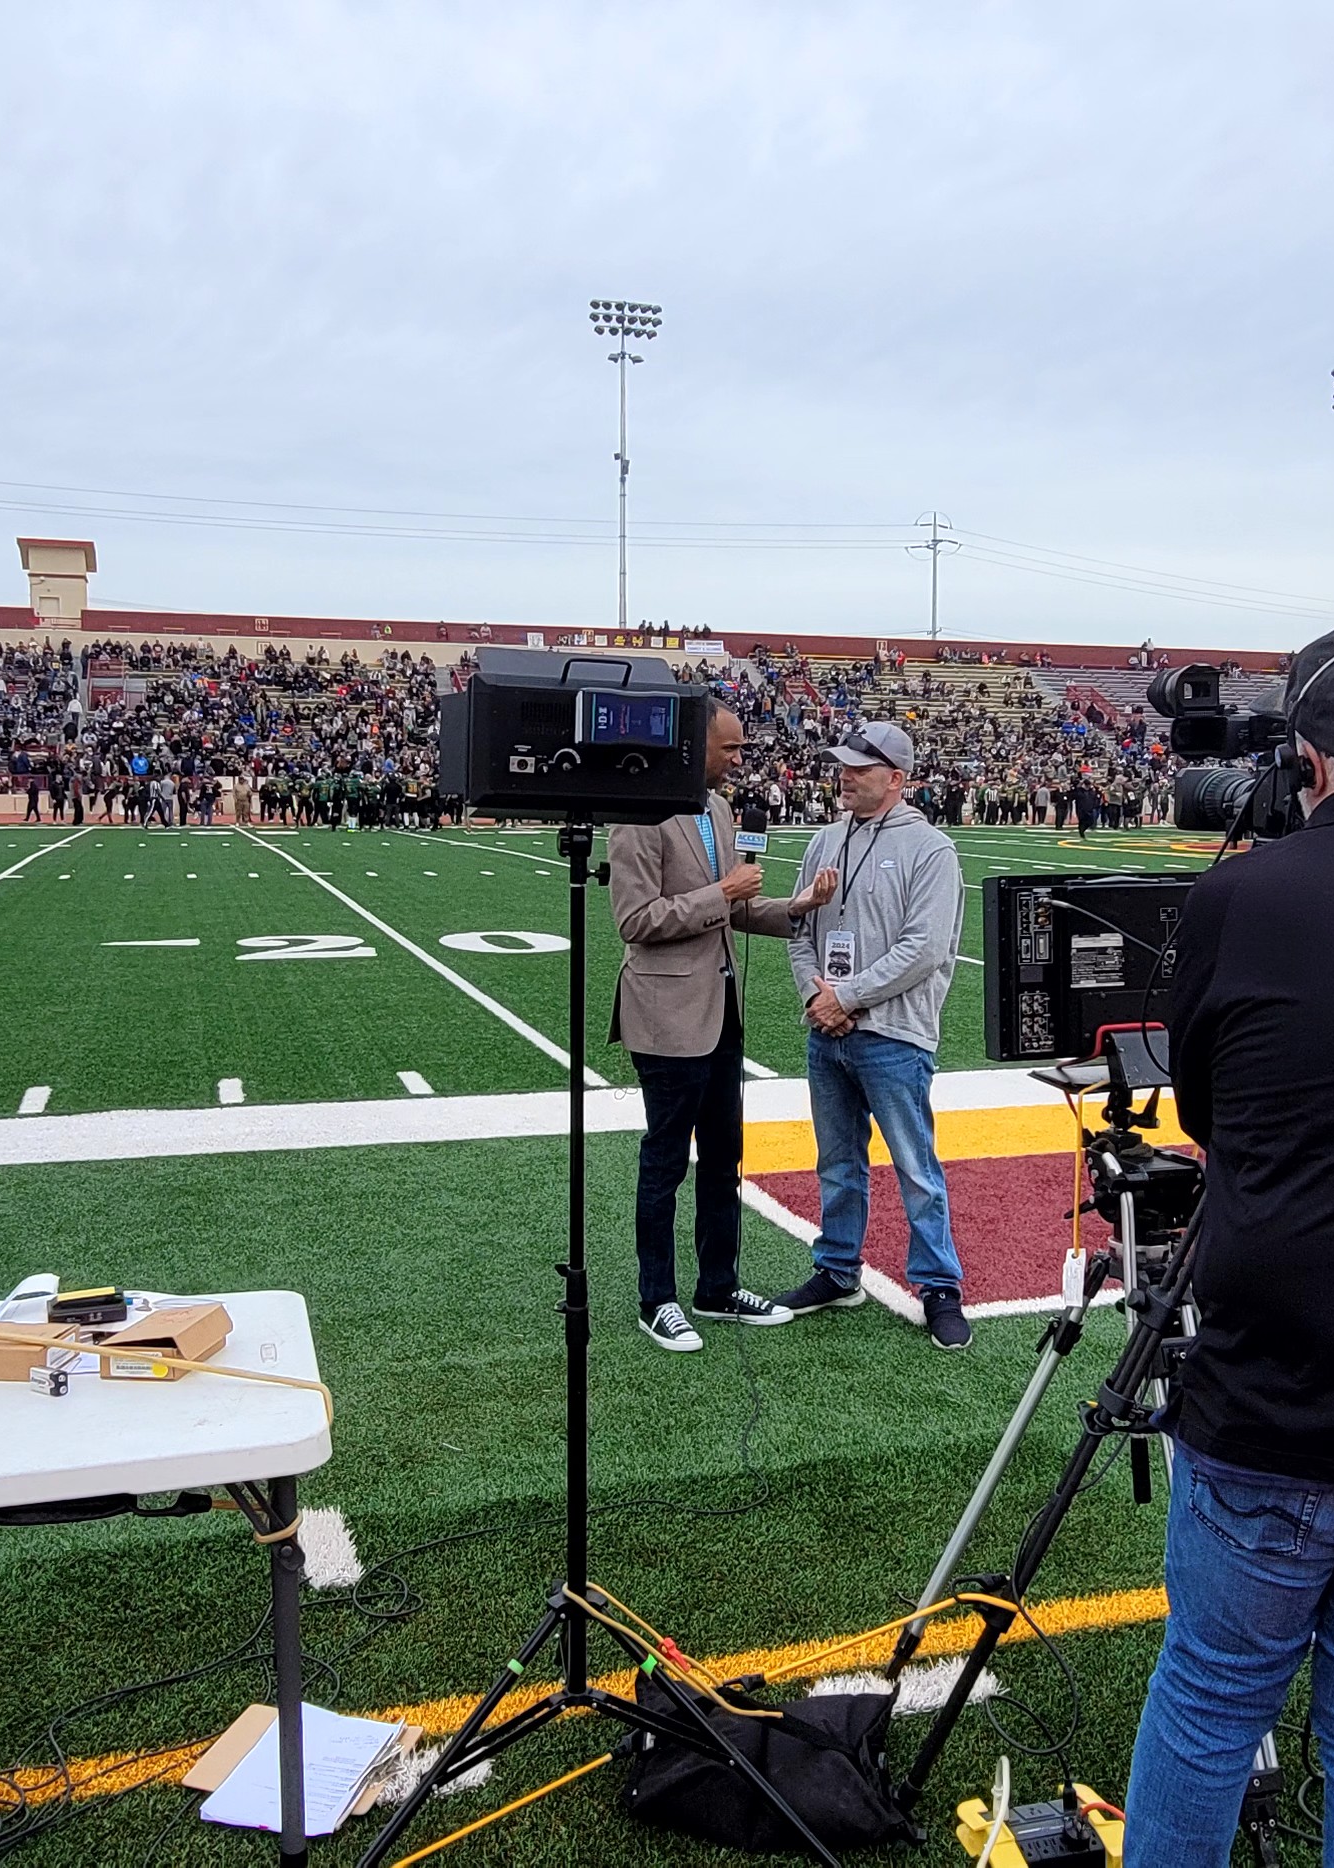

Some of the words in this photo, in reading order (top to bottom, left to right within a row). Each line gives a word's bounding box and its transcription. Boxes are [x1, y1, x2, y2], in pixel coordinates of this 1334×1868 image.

[737, 834, 765, 843] ACCESS
[235, 934, 571, 961] 20
[831, 942, 850, 950] 2024
